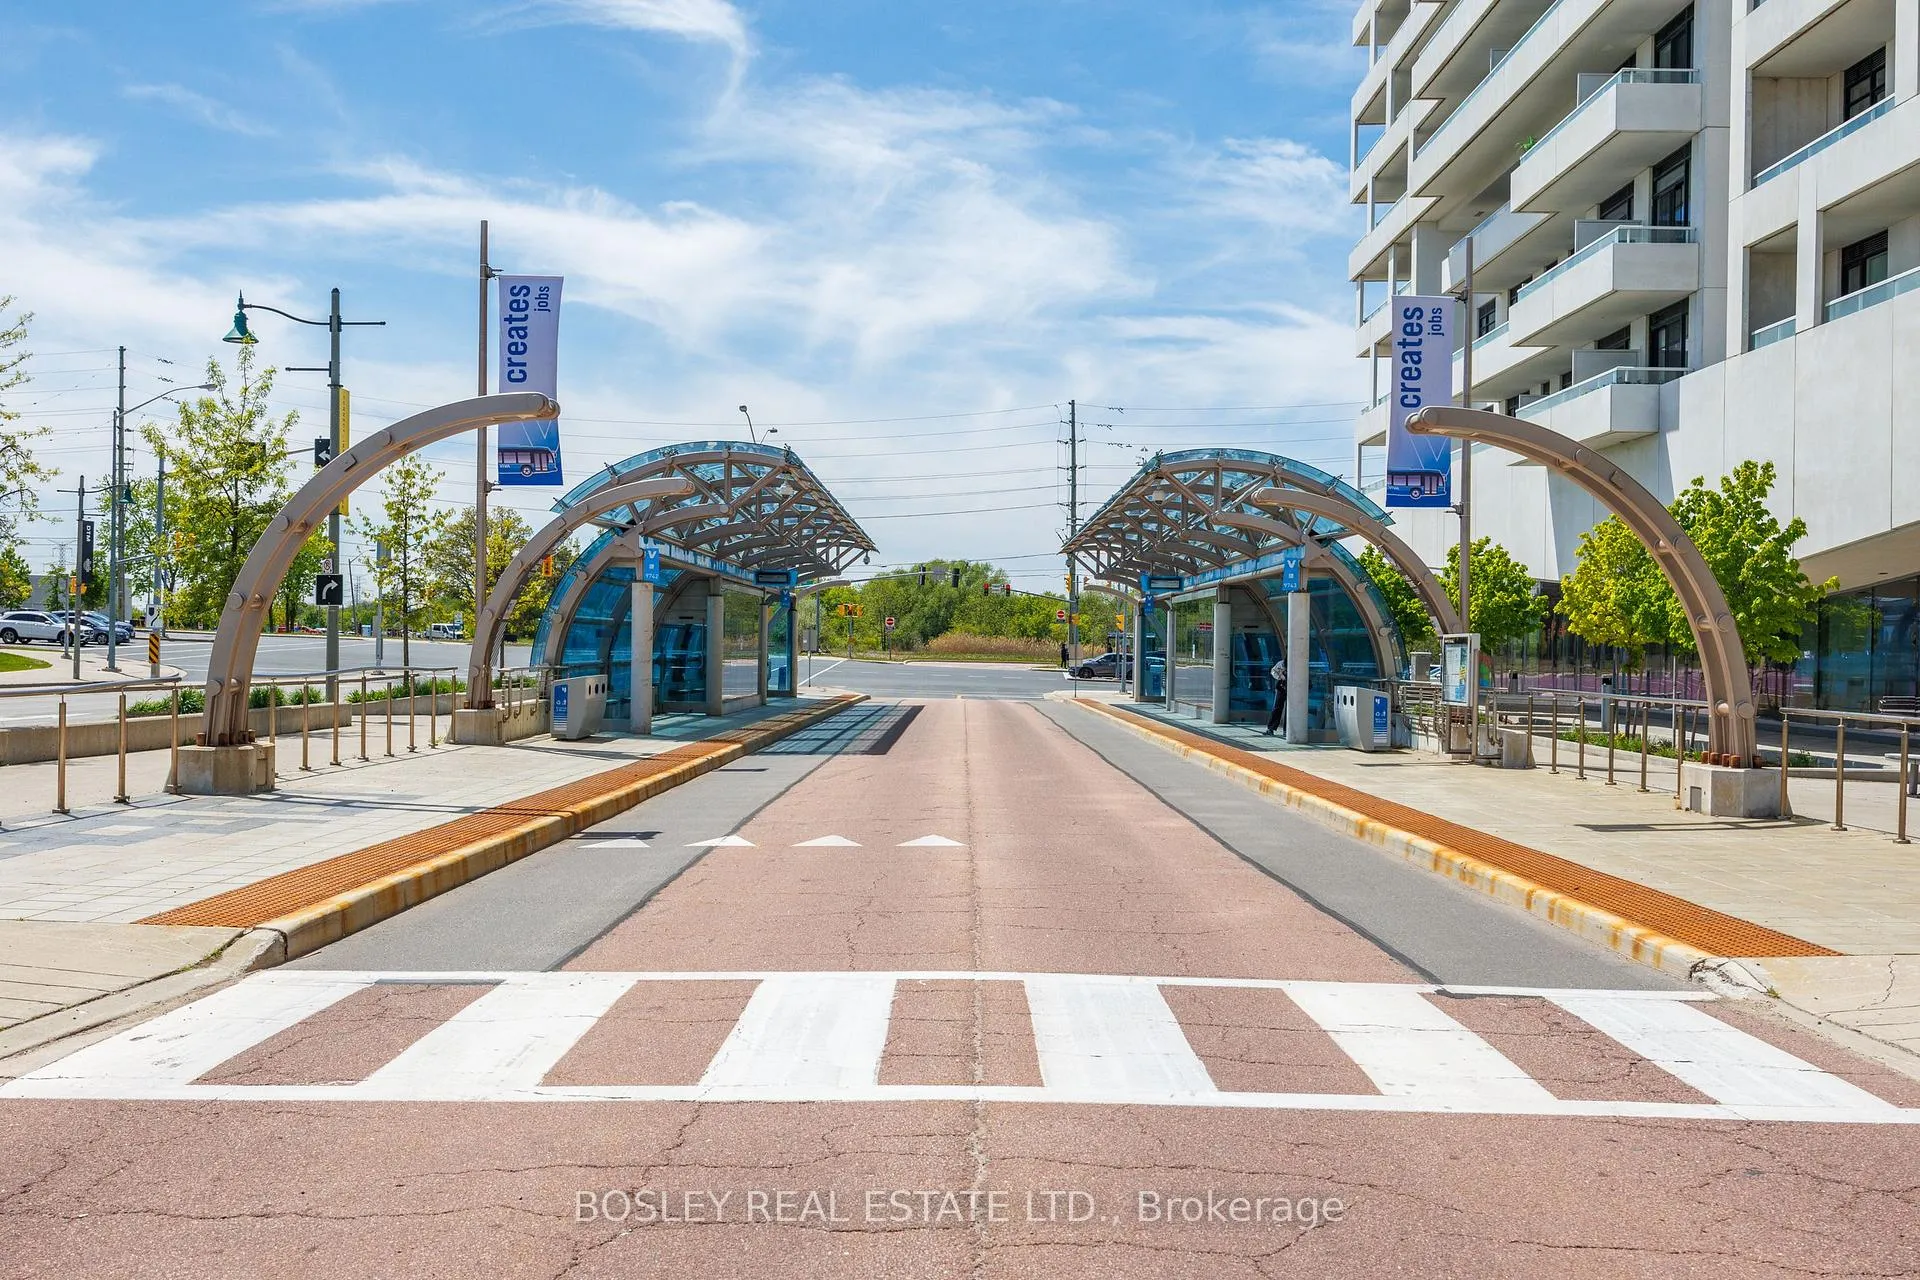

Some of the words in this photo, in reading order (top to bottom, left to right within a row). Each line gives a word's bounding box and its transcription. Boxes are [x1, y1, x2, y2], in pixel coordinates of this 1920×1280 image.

[534, 285, 551, 313] jobs
[1427, 307, 1445, 336] jobs
[504, 284, 531, 384] creates
[1397, 306, 1424, 408] creates
